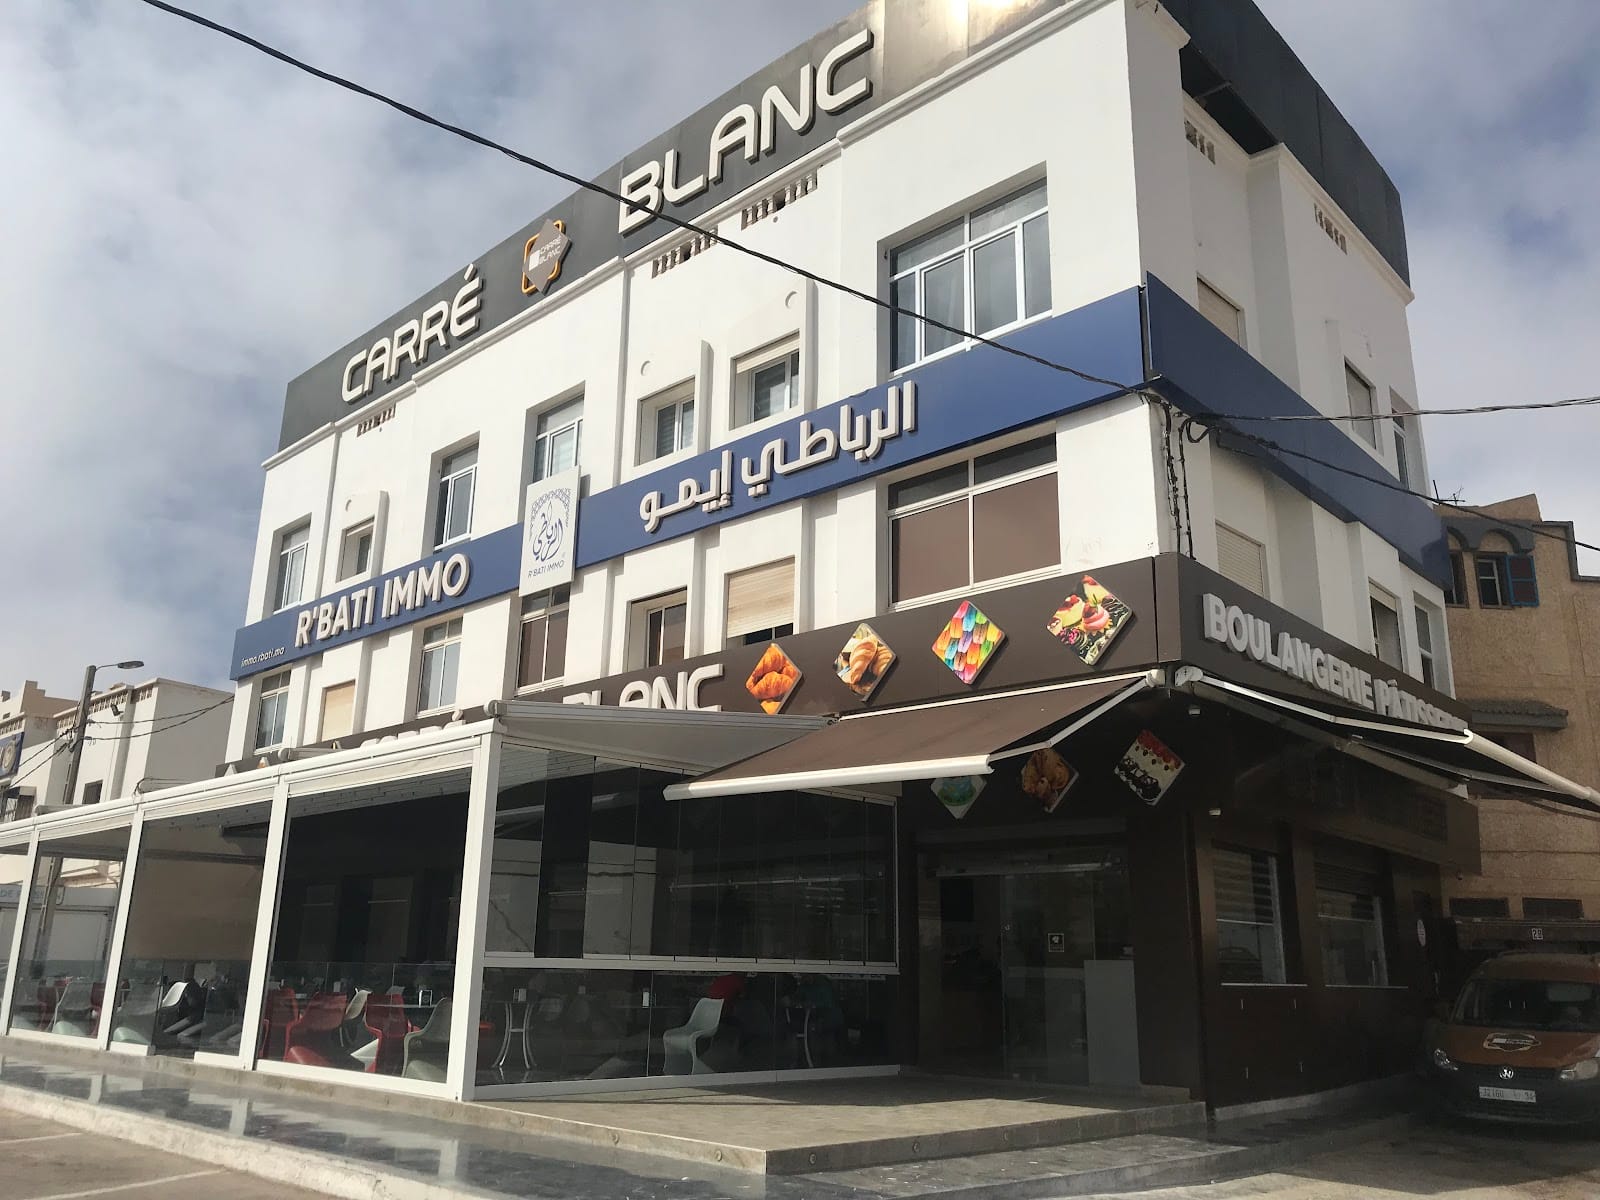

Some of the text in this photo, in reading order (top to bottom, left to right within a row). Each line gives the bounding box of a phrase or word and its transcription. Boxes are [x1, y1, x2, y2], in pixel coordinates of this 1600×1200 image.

[341, 28, 874, 403] CARRÉ BLANC
[639, 380, 917, 533] الرباطي إيمو
[294, 552, 471, 648] R'BATI IMMO
[546, 559, 565, 574] IMMO
[1202, 592, 1375, 711] BOULANGERIE
